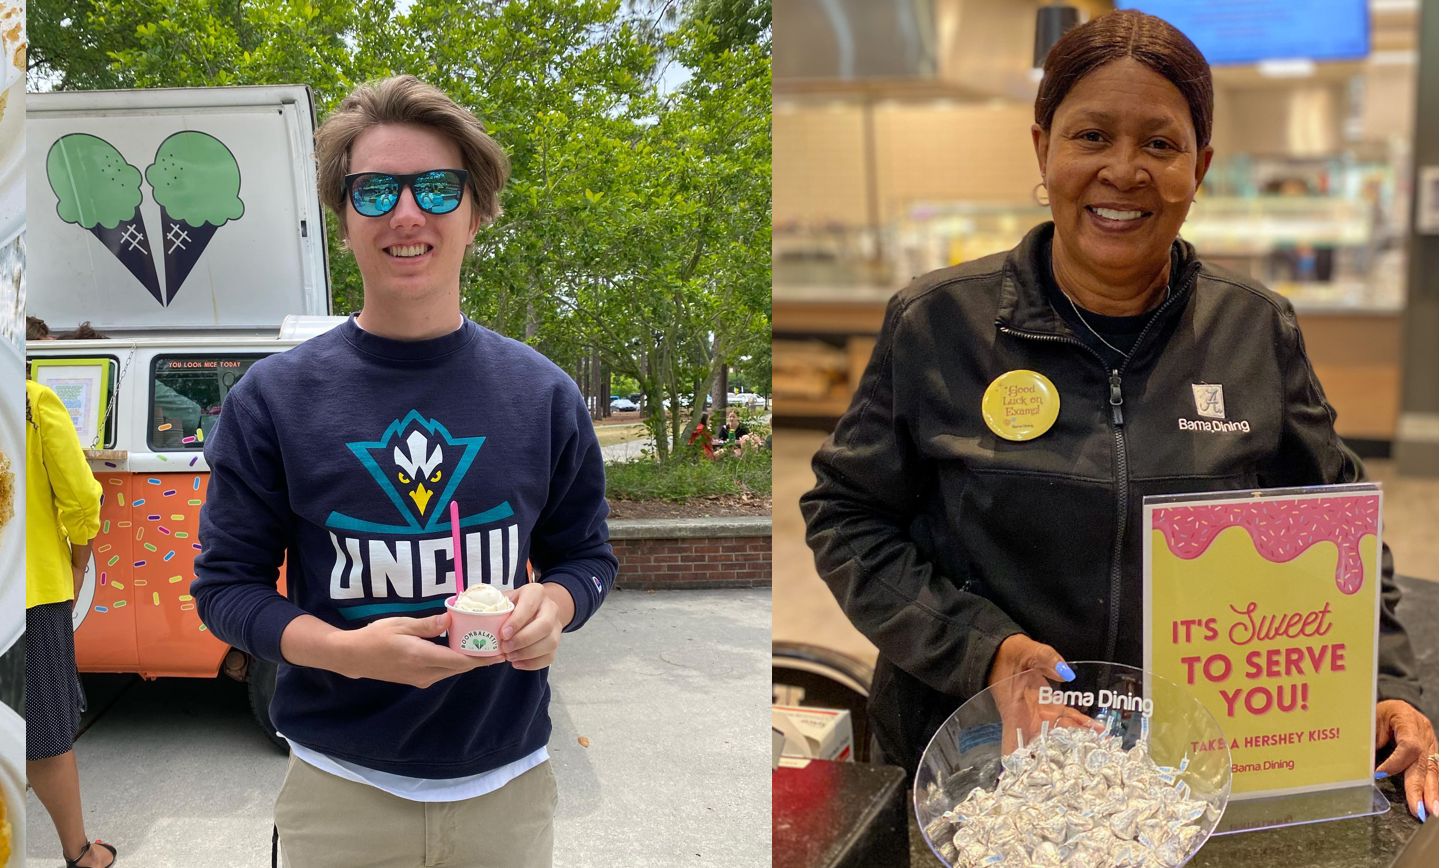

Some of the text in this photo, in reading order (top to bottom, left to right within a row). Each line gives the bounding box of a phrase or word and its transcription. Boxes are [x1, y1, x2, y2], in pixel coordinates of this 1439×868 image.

[1002, 396, 1043, 406] Luck on
[1008, 385, 1036, 398] Good
[1005, 404, 1040, 417] Exams!
[1178, 418, 1250, 433] Bama Dining
[1171, 601, 1333, 646] IT'S Sweet
[461, 631, 498, 650] BOOMBALATTI'S
[1180, 643, 1347, 685] TO SERVE
[1038, 686, 1154, 718] Bama Dining
[1218, 683, 1310, 718] YOU!
[1191, 727, 1341, 754] TAKE A HERSHEY KISS!
[1231, 760, 1295, 774] Bama Dining
